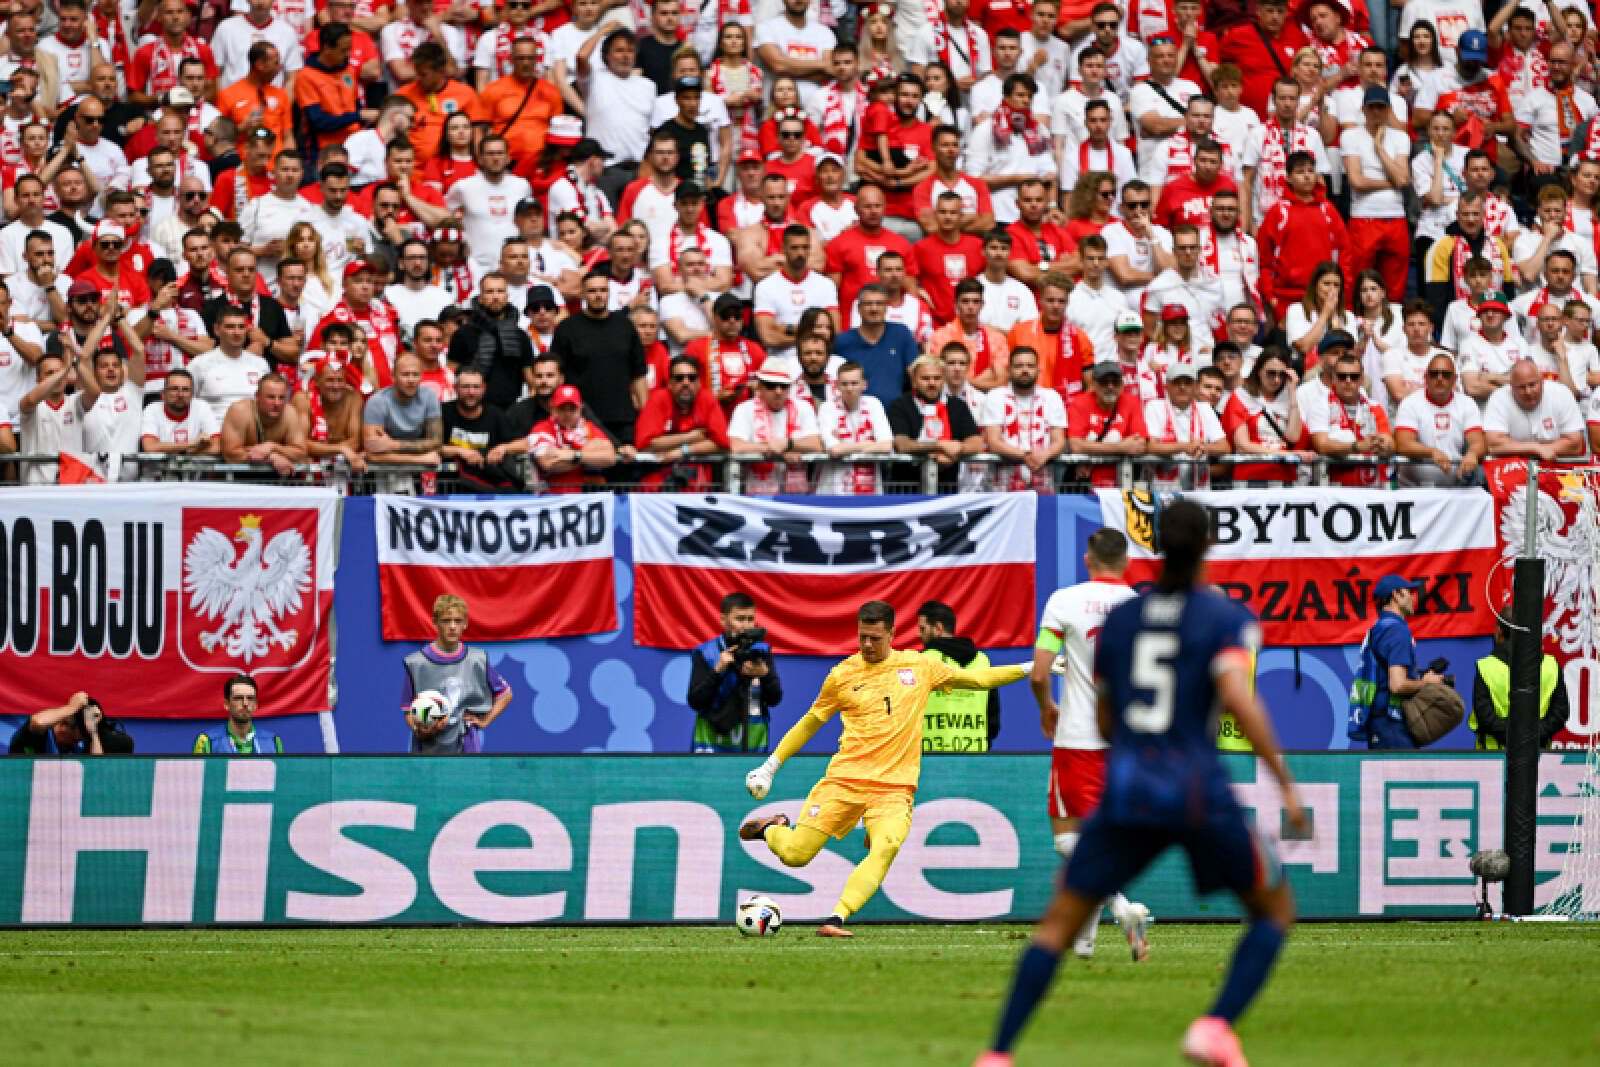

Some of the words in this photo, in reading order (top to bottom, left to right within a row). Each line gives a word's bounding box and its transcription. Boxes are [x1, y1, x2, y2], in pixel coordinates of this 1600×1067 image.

[388, 502, 605, 553] NOWOGARD
[676, 496, 995, 565] ŻARY
[1207, 501, 1416, 544] BYTOM
[52, 518, 164, 656] BOJU
[884, 696, 891, 715] 1
[1124, 631, 1179, 733] 5
[923, 713, 985, 730] TEWAR
[21, 760, 1020, 922] Hisense
